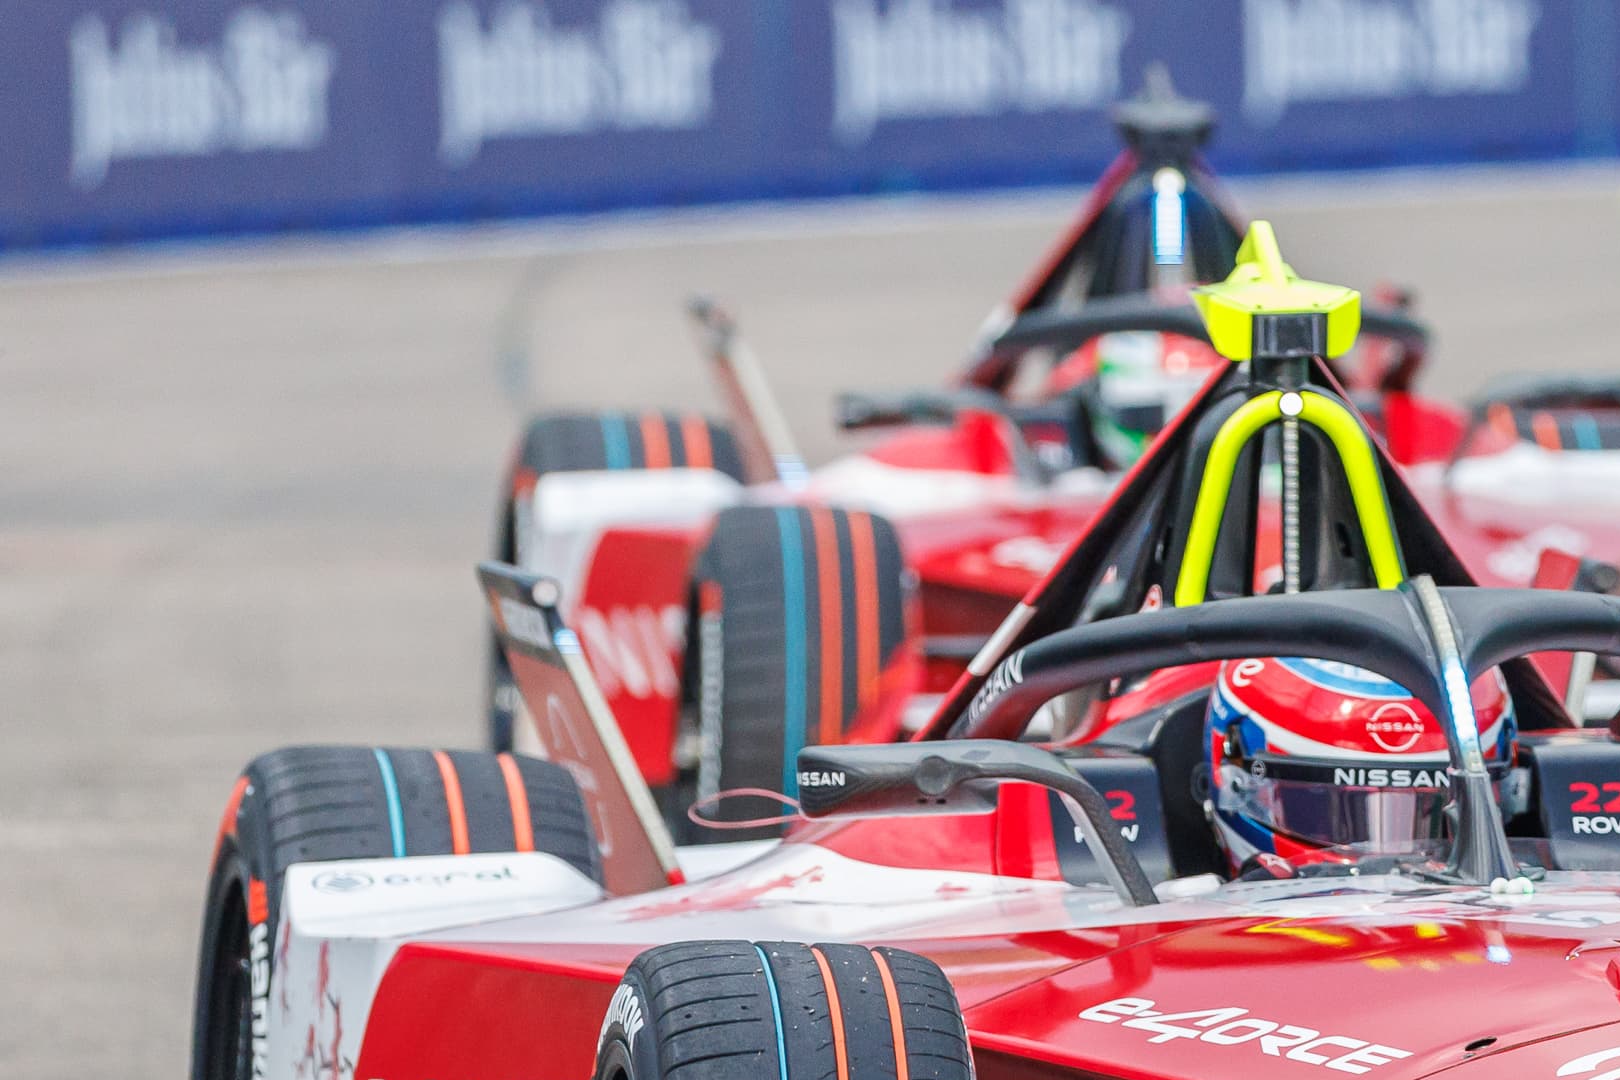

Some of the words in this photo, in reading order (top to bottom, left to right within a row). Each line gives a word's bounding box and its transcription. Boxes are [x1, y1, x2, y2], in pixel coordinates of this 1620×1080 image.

[1366, 721, 1425, 733] NISSAN
[798, 771, 846, 786] ISSAN
[1334, 767, 1451, 788] NISSAN
